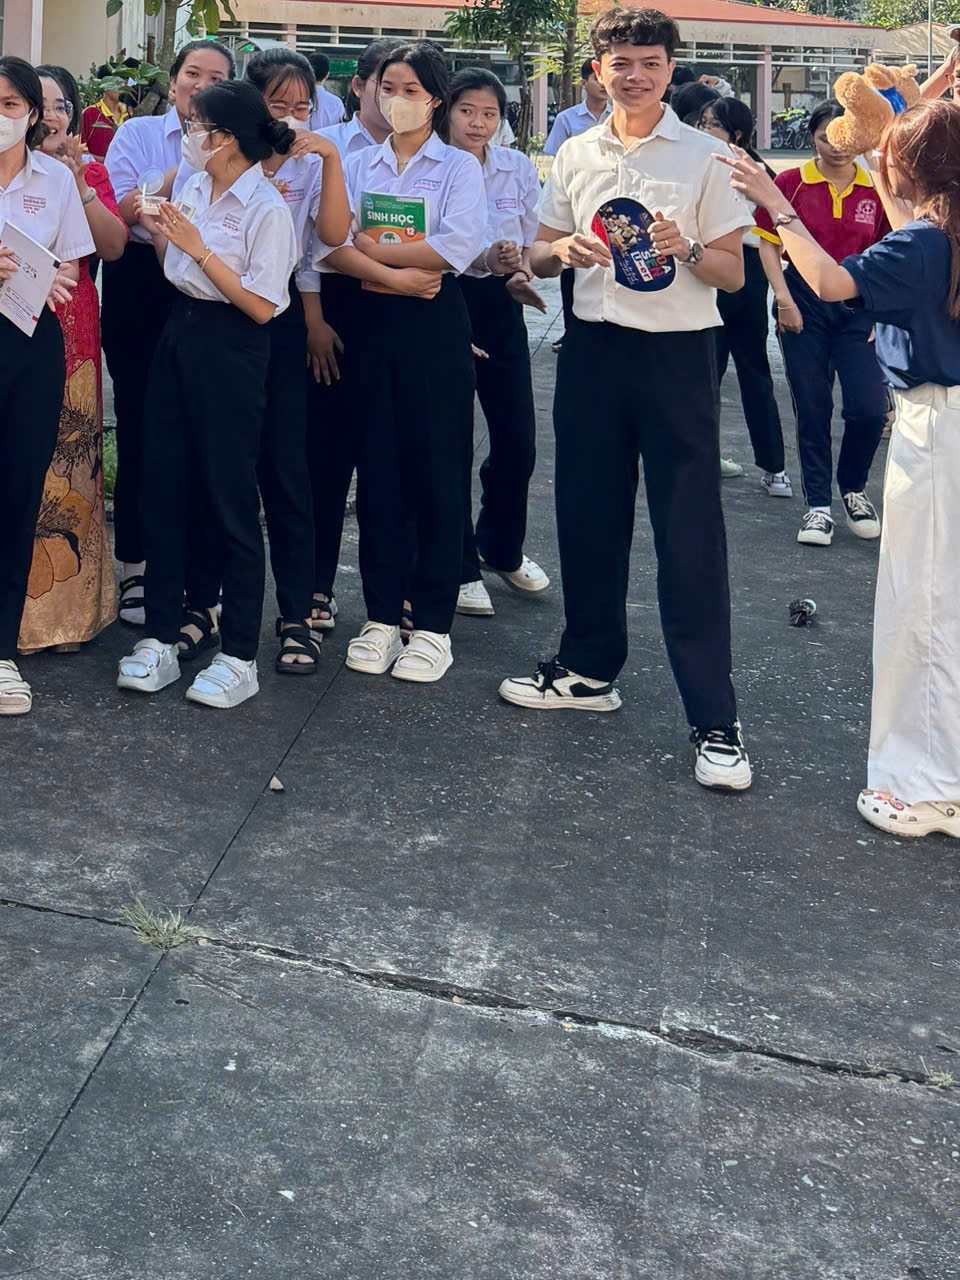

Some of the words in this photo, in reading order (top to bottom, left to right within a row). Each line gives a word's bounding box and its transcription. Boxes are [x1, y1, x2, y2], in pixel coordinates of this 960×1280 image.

[367, 210, 388, 222] SINH
[390, 214, 415, 226] HỌC
[406, 227, 416, 236] 12
